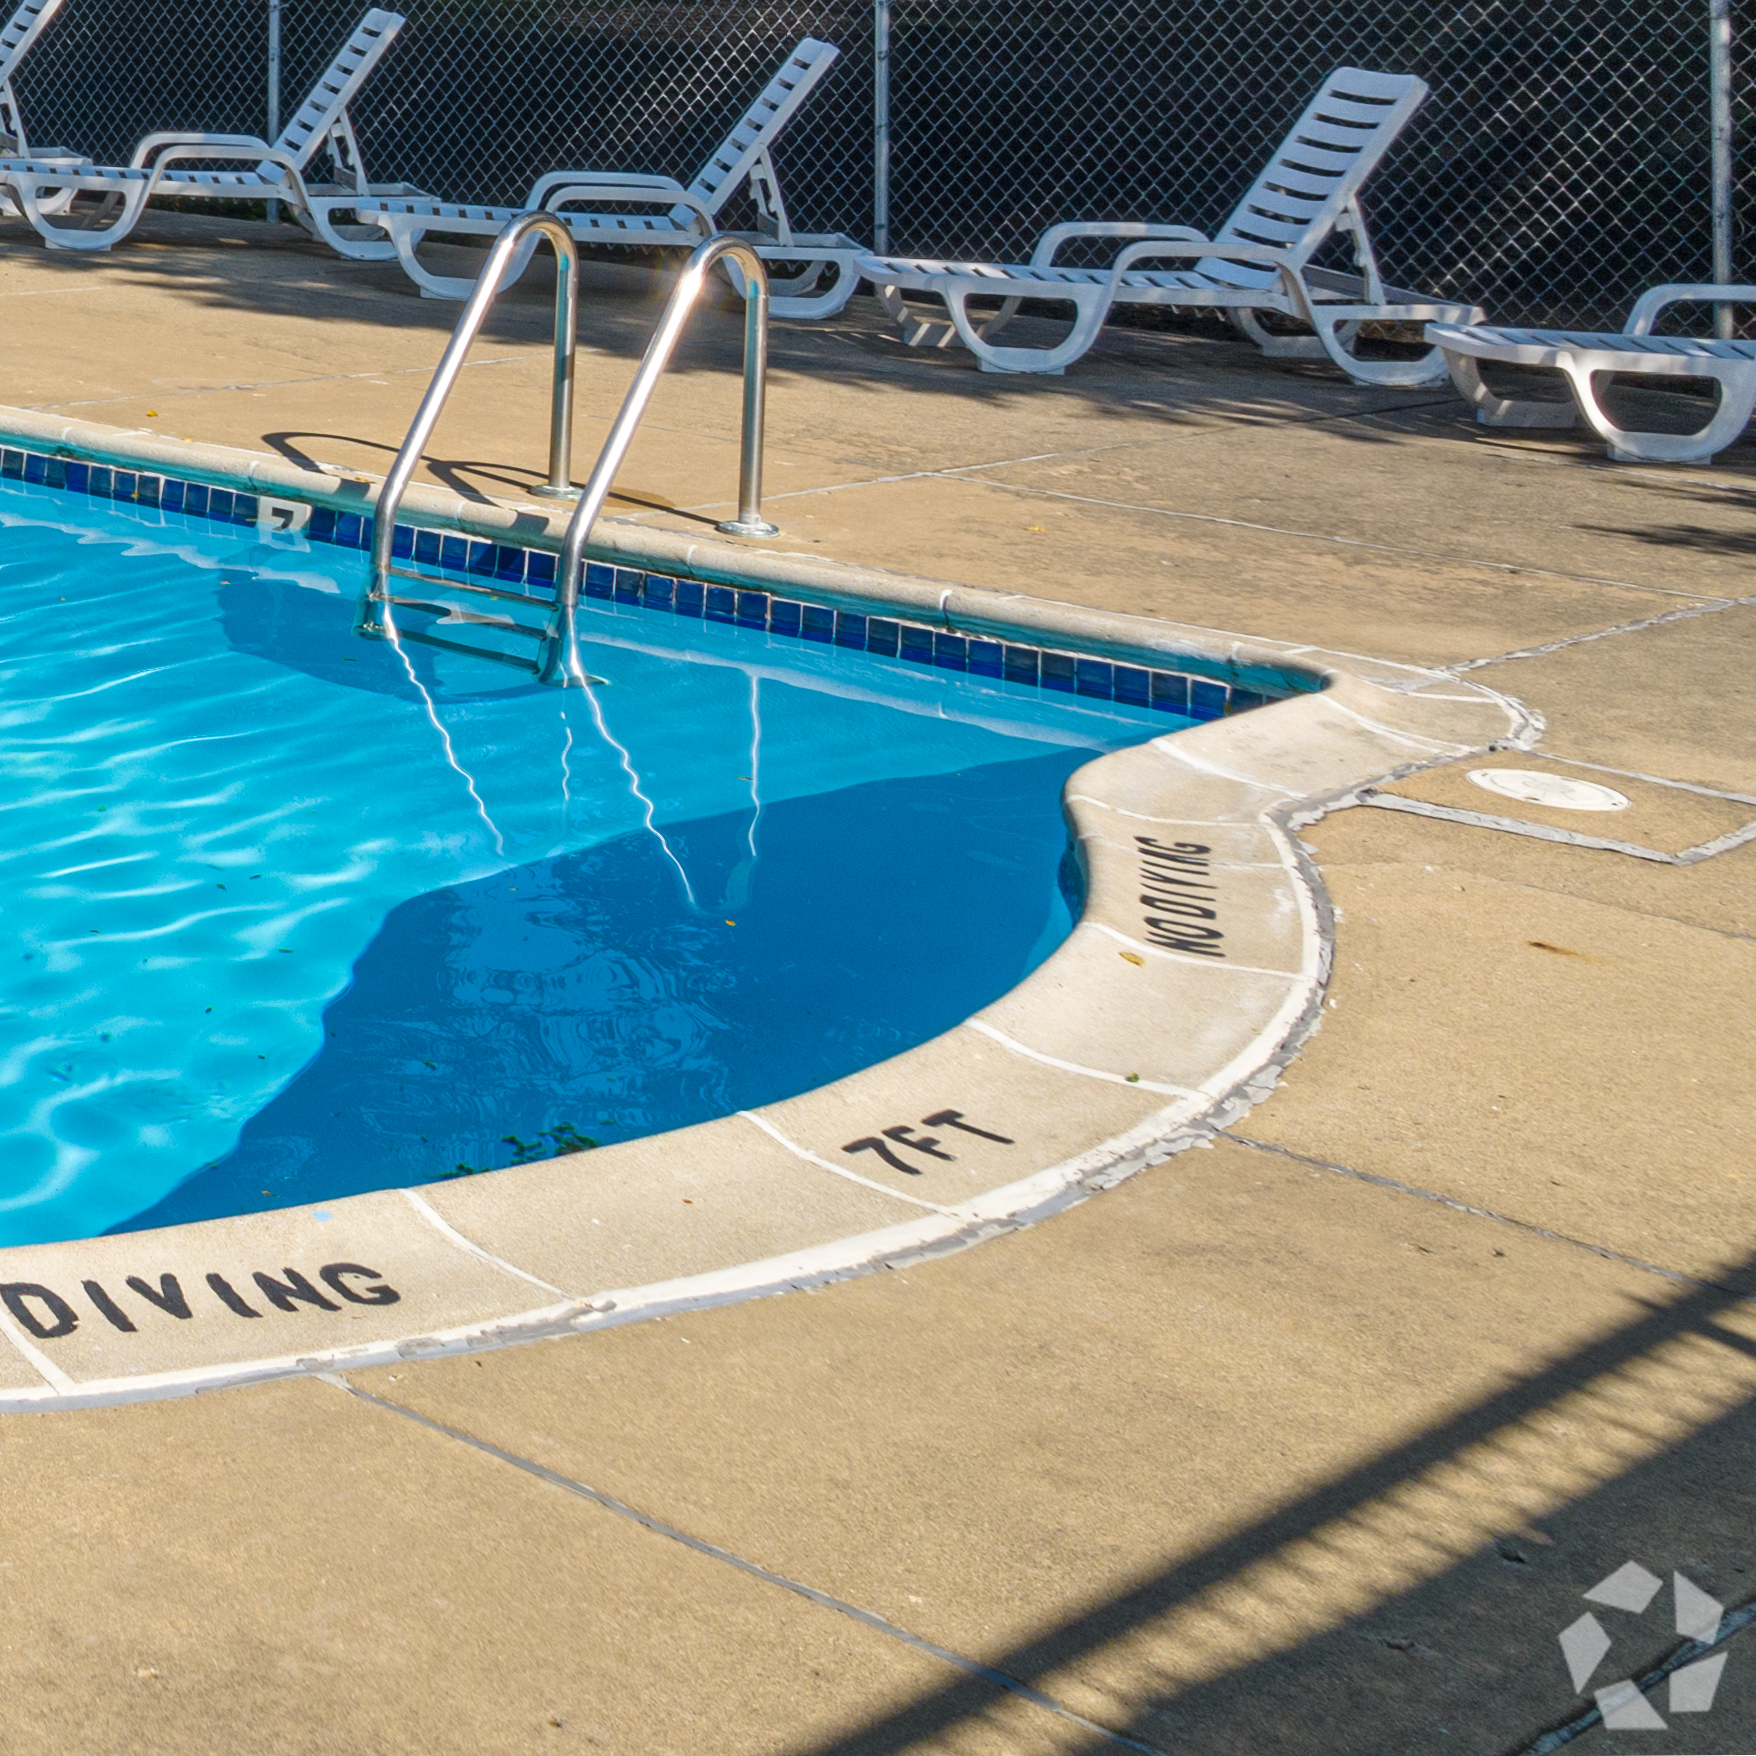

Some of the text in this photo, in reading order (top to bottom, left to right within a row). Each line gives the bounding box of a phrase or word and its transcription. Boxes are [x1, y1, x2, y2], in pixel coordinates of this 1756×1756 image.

[1133, 835, 1226, 958] NO DIVING
[841, 1108, 1016, 1176] 7FT
